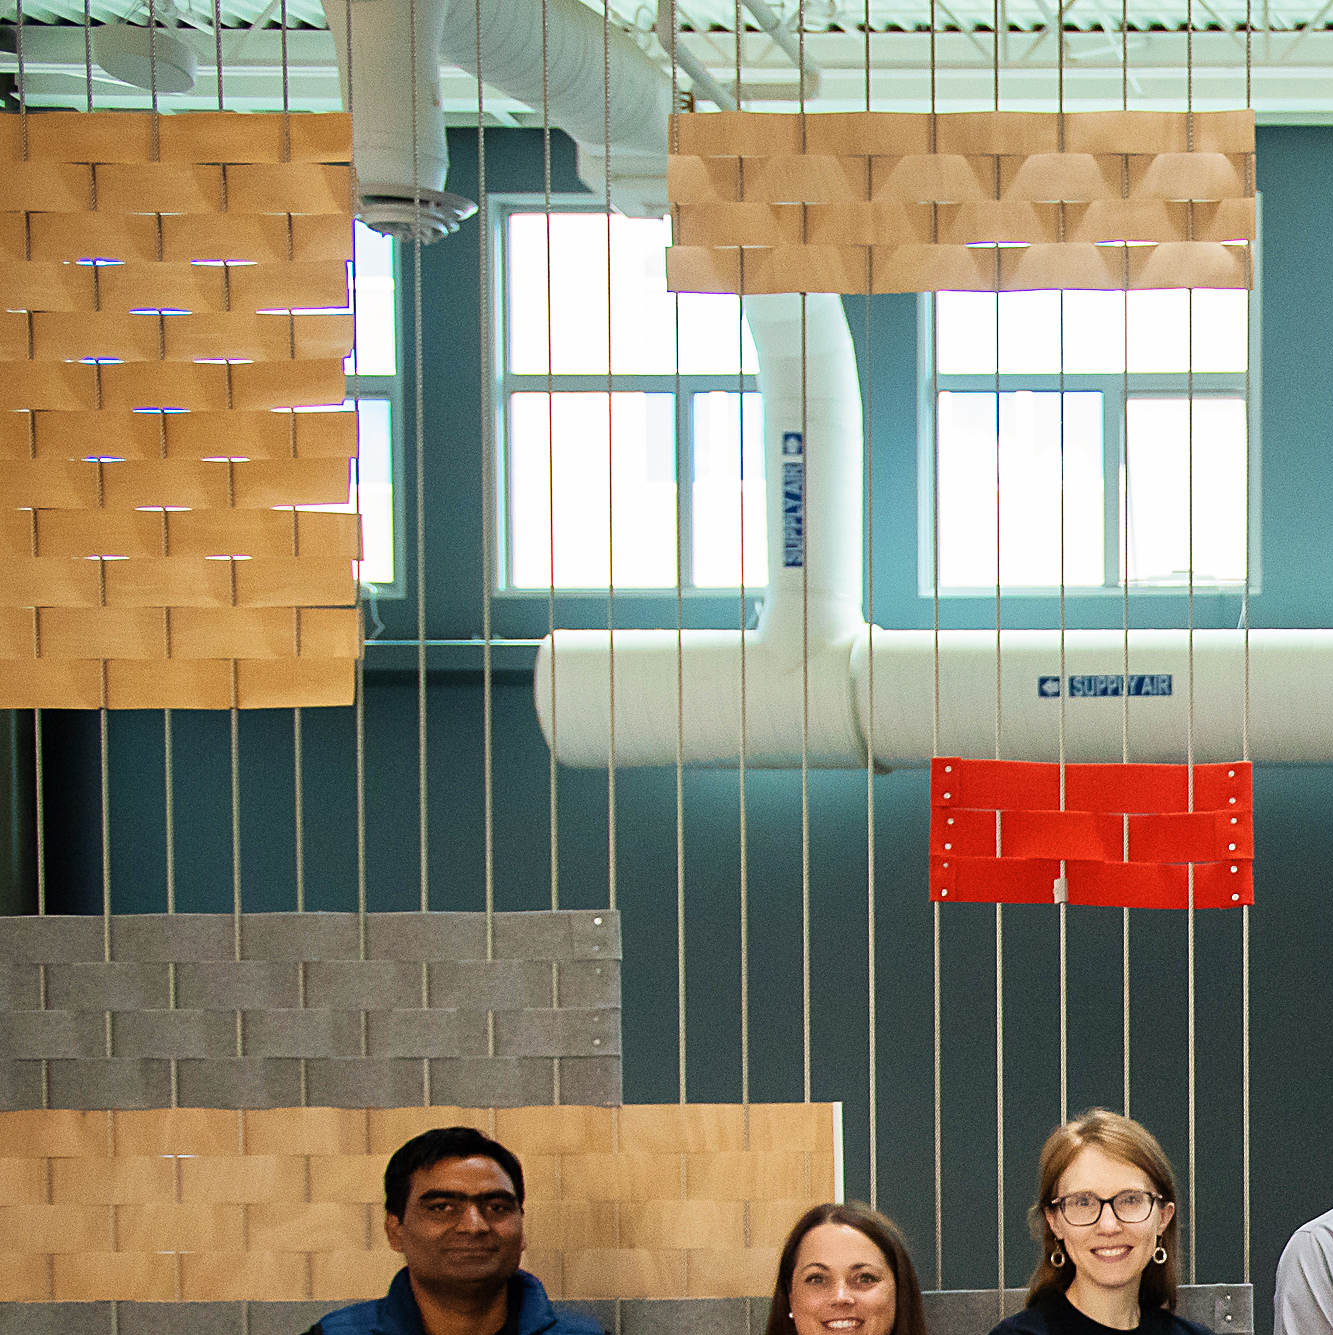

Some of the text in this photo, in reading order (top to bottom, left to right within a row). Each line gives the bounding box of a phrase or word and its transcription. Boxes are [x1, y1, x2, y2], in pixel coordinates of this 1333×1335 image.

[784, 464, 802, 563] SUPPLY AIR
[1072, 675, 1171, 696] SUPPLY AIR
